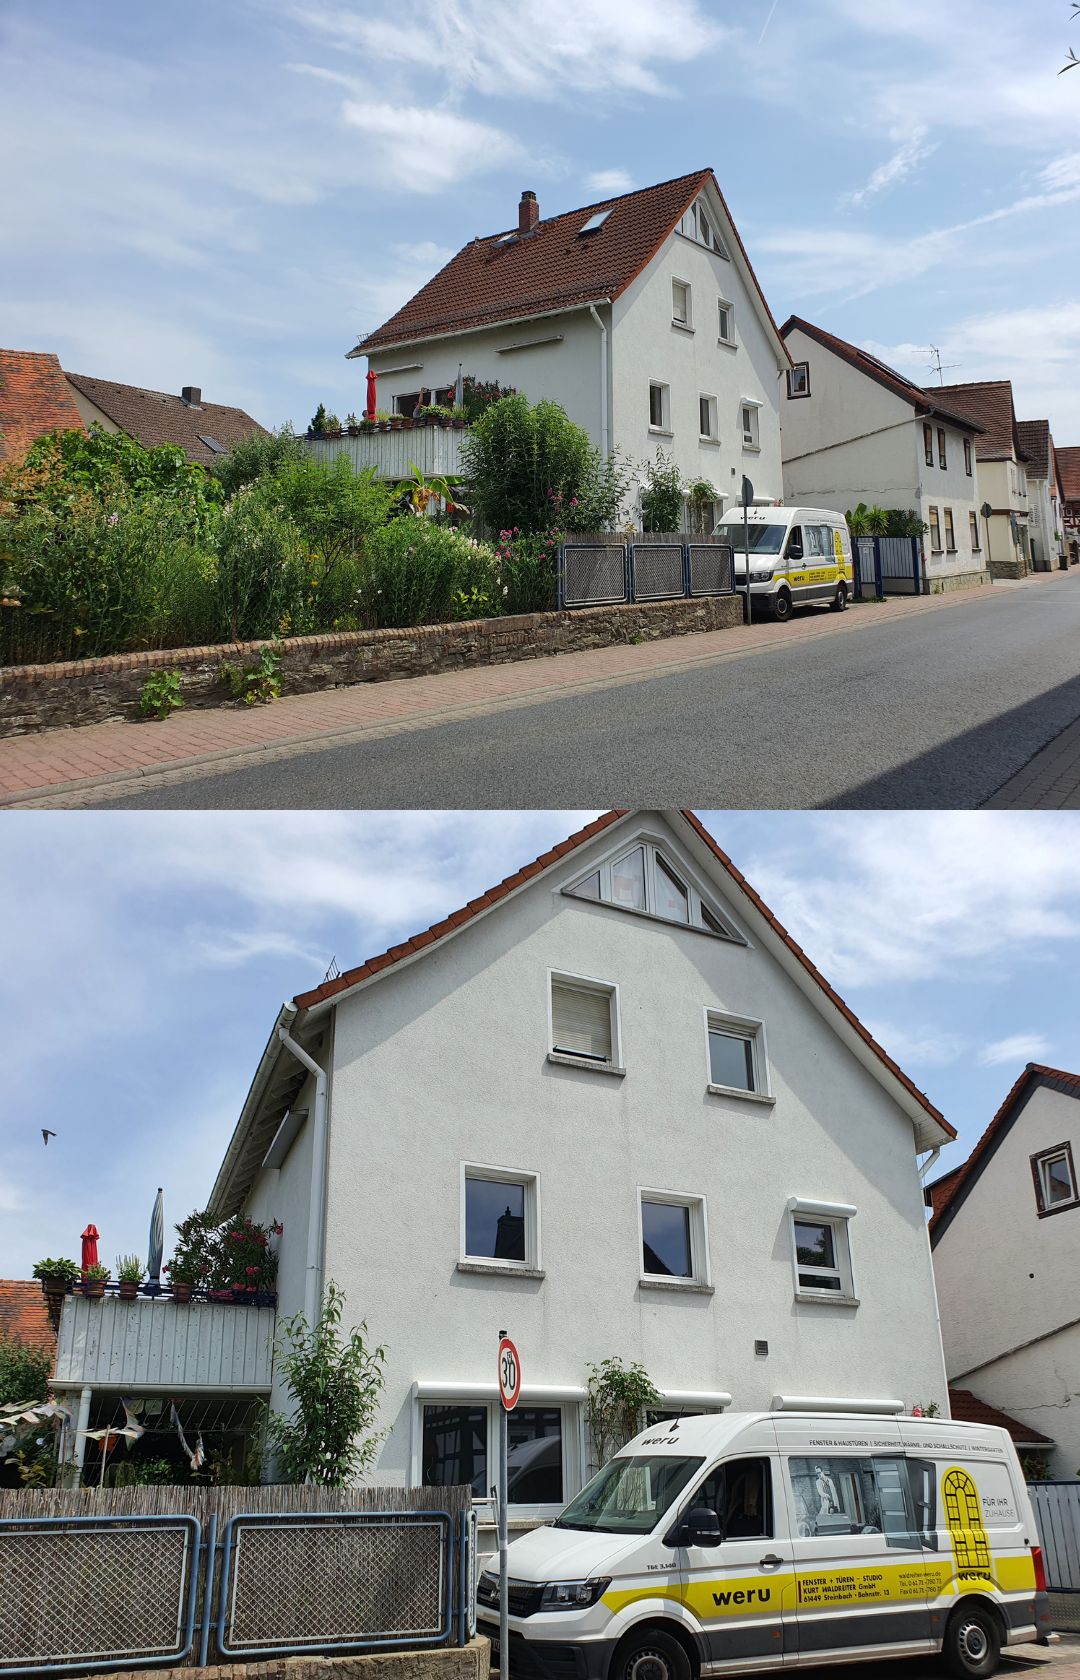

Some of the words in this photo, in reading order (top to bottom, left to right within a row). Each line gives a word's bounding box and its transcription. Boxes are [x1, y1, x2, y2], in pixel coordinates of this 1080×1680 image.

[501, 1356, 516, 1391] 30
[641, 1437, 680, 1446] weru
[982, 1496, 996, 1506] FÜR
[997, 1498, 1008, 1506] IHR
[984, 1509, 1015, 1518] ZUHAUSE
[803, 1578, 827, 1586] FENSTER
[835, 1576, 855, 1584] TÜREN
[862, 1574, 883, 1582] STUDIO
[957, 1571, 991, 1581] weru
[822, 1584, 856, 1593] WALDREITER
[712, 1588, 771, 1606] weru
[804, 1595, 821, 1603] 61449
[824, 1592, 853, 1601] Steinbach
[857, 1590, 882, 1598] Bahnstr.
